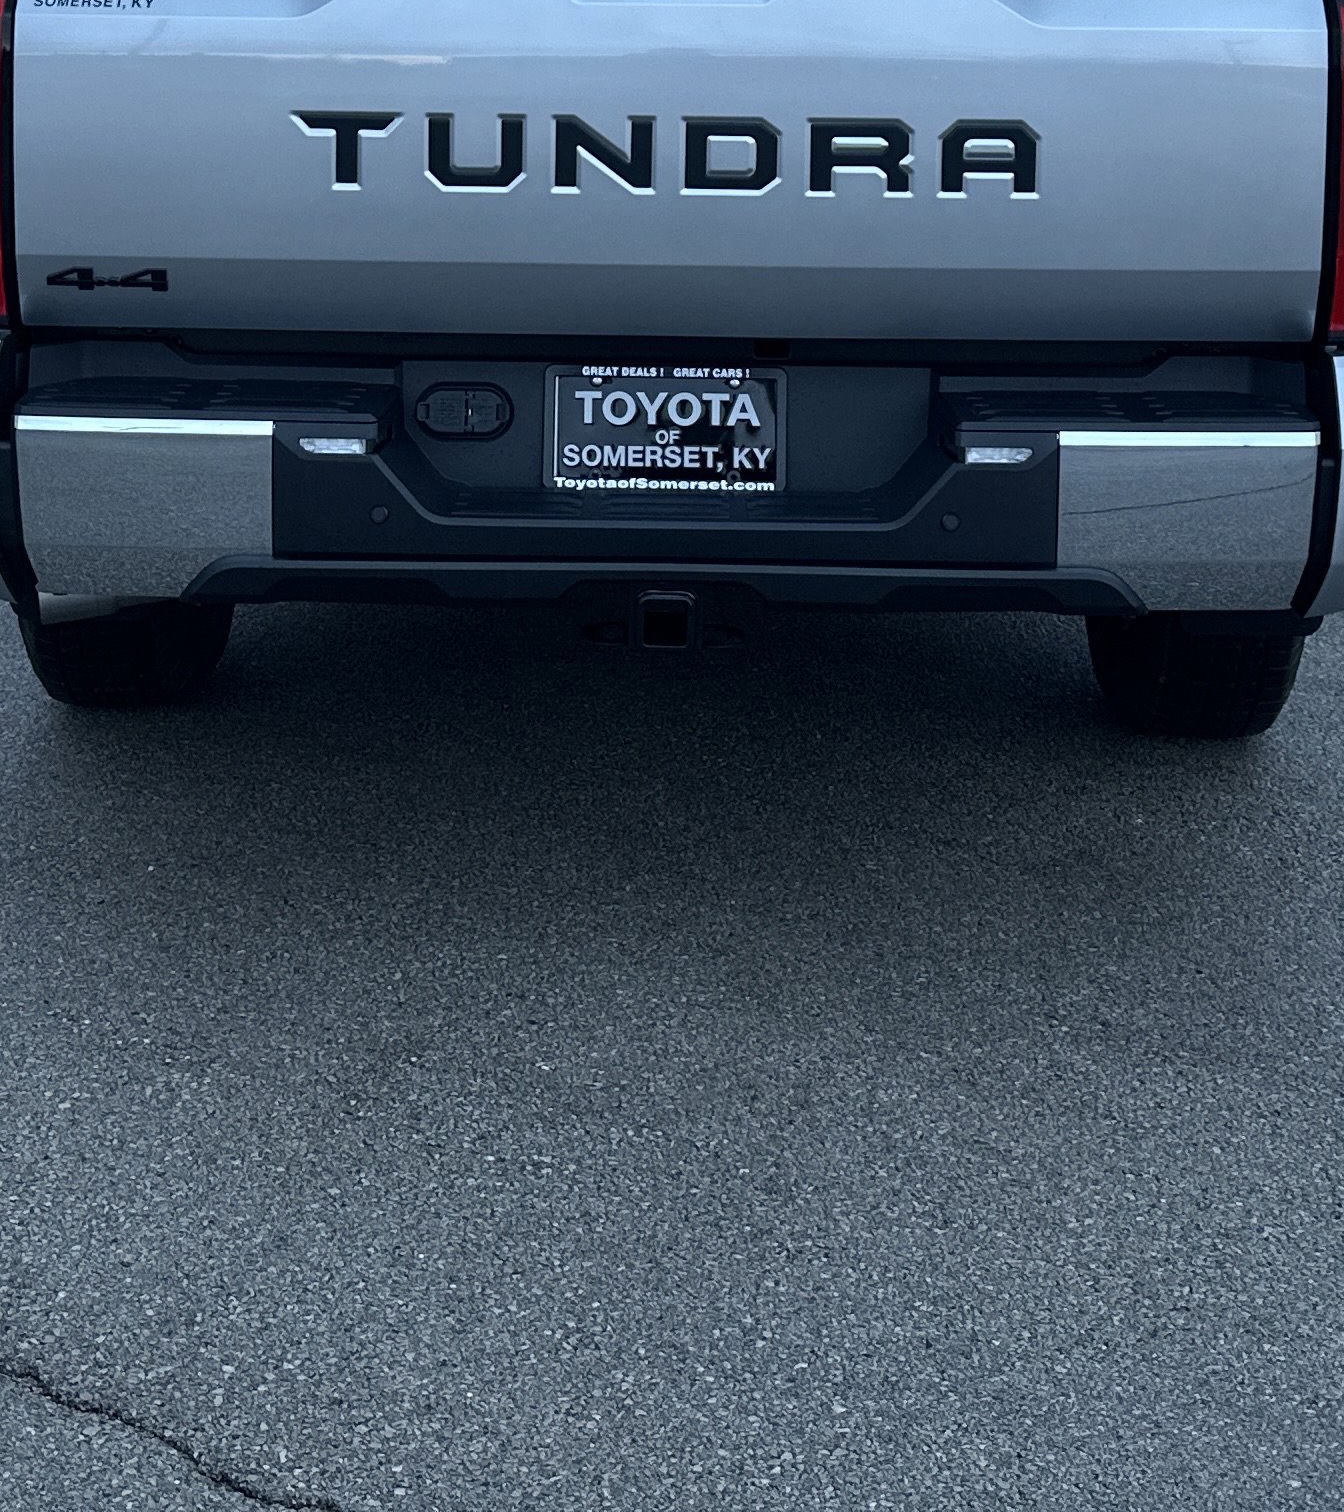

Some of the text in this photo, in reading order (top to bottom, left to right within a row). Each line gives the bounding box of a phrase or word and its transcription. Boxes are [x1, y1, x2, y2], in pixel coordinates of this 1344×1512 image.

[289, 111, 1043, 200] TUNDRA
[582, 366, 619, 377] GREAT
[673, 367, 710, 378] GREAT
[575, 390, 761, 427] TOYOTA
[655, 429, 681, 445] OF
[562, 444, 772, 472] SOMERSET, KY
[553, 476, 775, 491] ToyotaofSomerset.com
